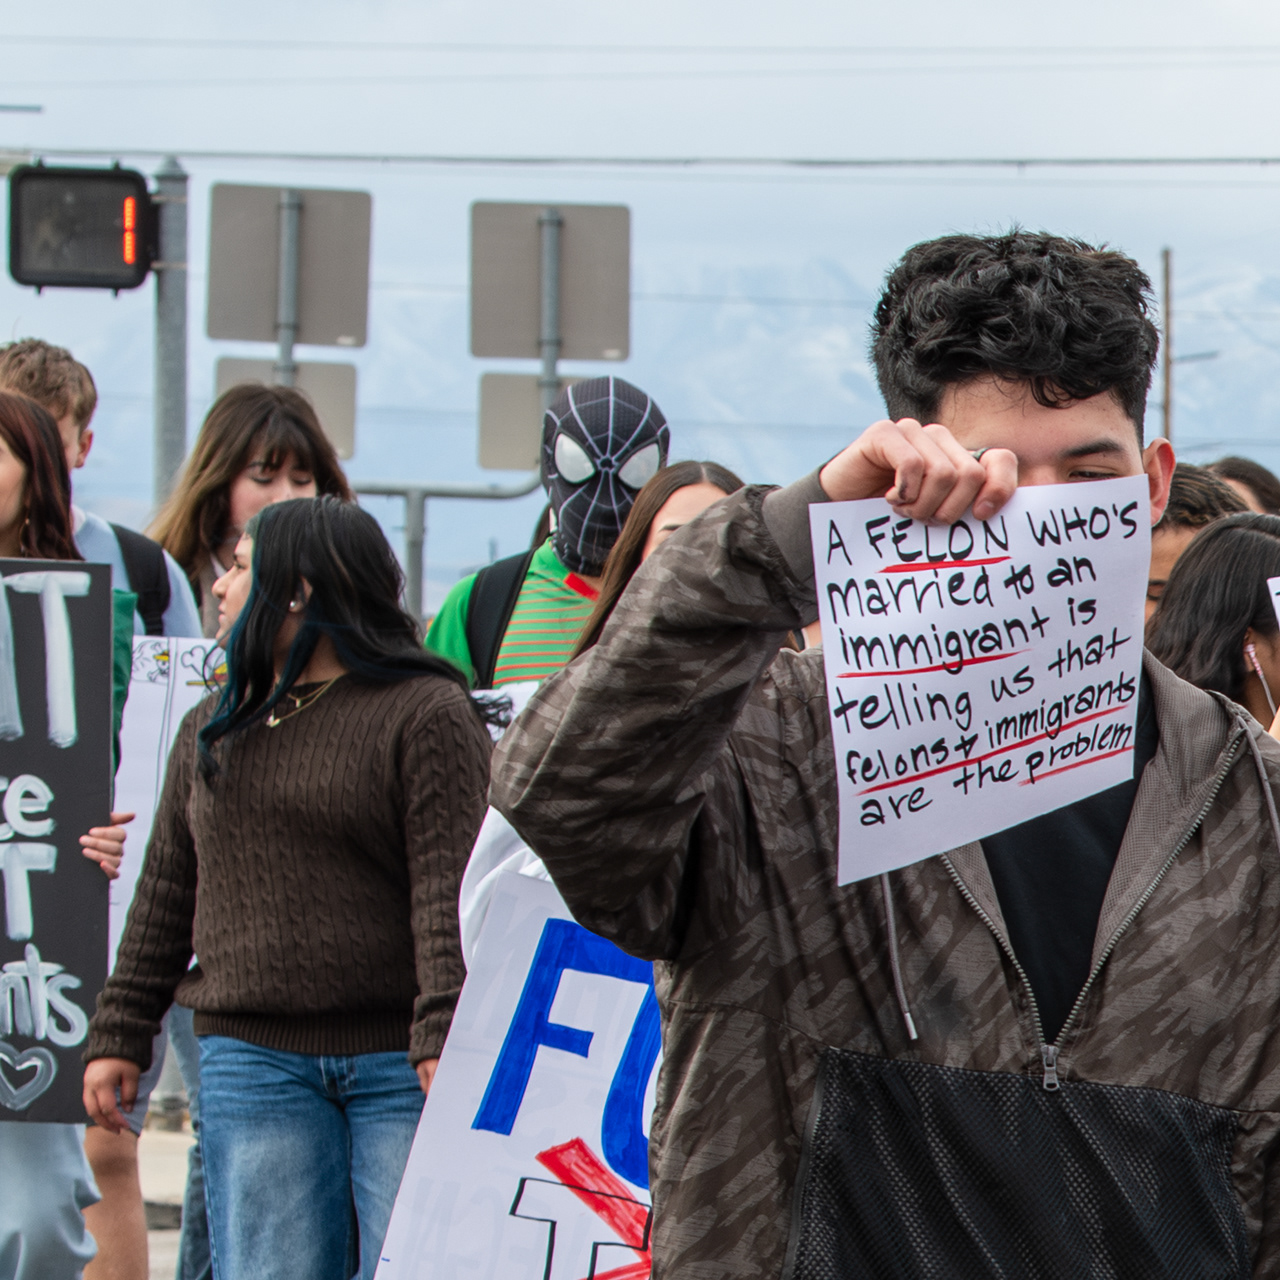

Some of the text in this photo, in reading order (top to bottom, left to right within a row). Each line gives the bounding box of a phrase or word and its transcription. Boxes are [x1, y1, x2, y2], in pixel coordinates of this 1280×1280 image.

[826, 499, 1139, 567] A FELON WHO'S
[827, 556, 1097, 625] married to an
[838, 597, 1097, 674] immigrant is
[0, 570, 91, 748] T
[834, 627, 1132, 735] telling us that
[846, 738, 949, 785] felons
[984, 671, 1136, 750] immigrants
[860, 722, 1133, 828] are the problem
